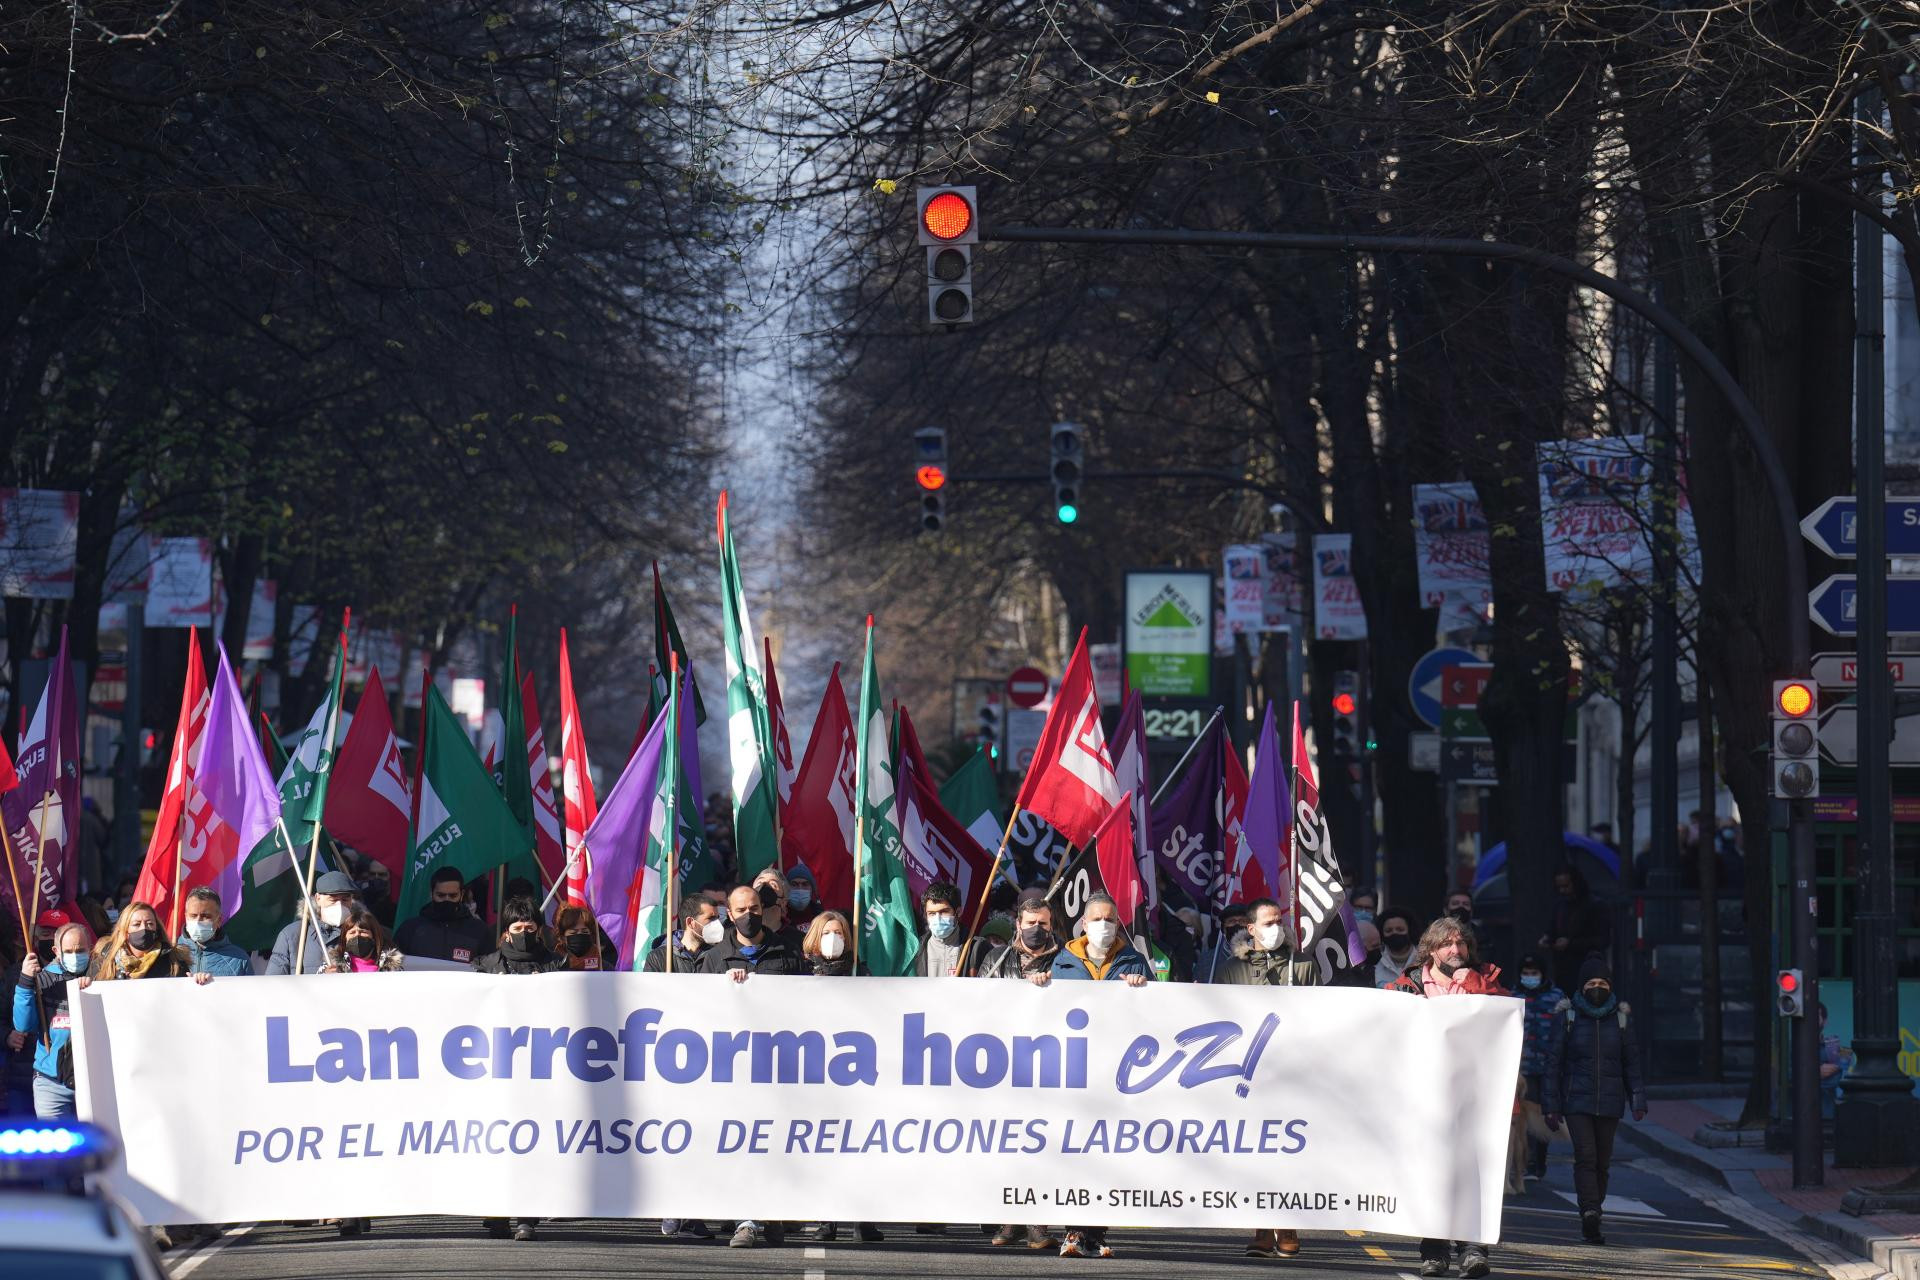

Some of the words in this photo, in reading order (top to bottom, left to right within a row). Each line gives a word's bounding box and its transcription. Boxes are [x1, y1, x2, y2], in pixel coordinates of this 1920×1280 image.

[1904, 508, 1920, 526] S
[1142, 708, 1201, 737] 2:21
[266, 1016, 419, 1084] Lan
[441, 1008, 878, 1087] erreforma
[902, 1008, 1088, 1089] honi
[1116, 1012, 1279, 1098] ez!
[235, 1127, 322, 1165] POR
[338, 1123, 384, 1158] EL
[398, 1119, 540, 1156] MARCO
[556, 1119, 692, 1155] VASCO
[717, 1119, 774, 1154] DE
[786, 1118, 1048, 1154] RELACIONES
[1061, 1118, 1308, 1154] LABORALES
[1003, 1187, 1037, 1205] ELA
[1055, 1188, 1090, 1206] LAB
[1108, 1189, 1184, 1209] STEILAS
[1202, 1191, 1238, 1209] ESK
[1256, 1191, 1339, 1211] ETXALDE
[1357, 1194, 1398, 1214] HIRU
